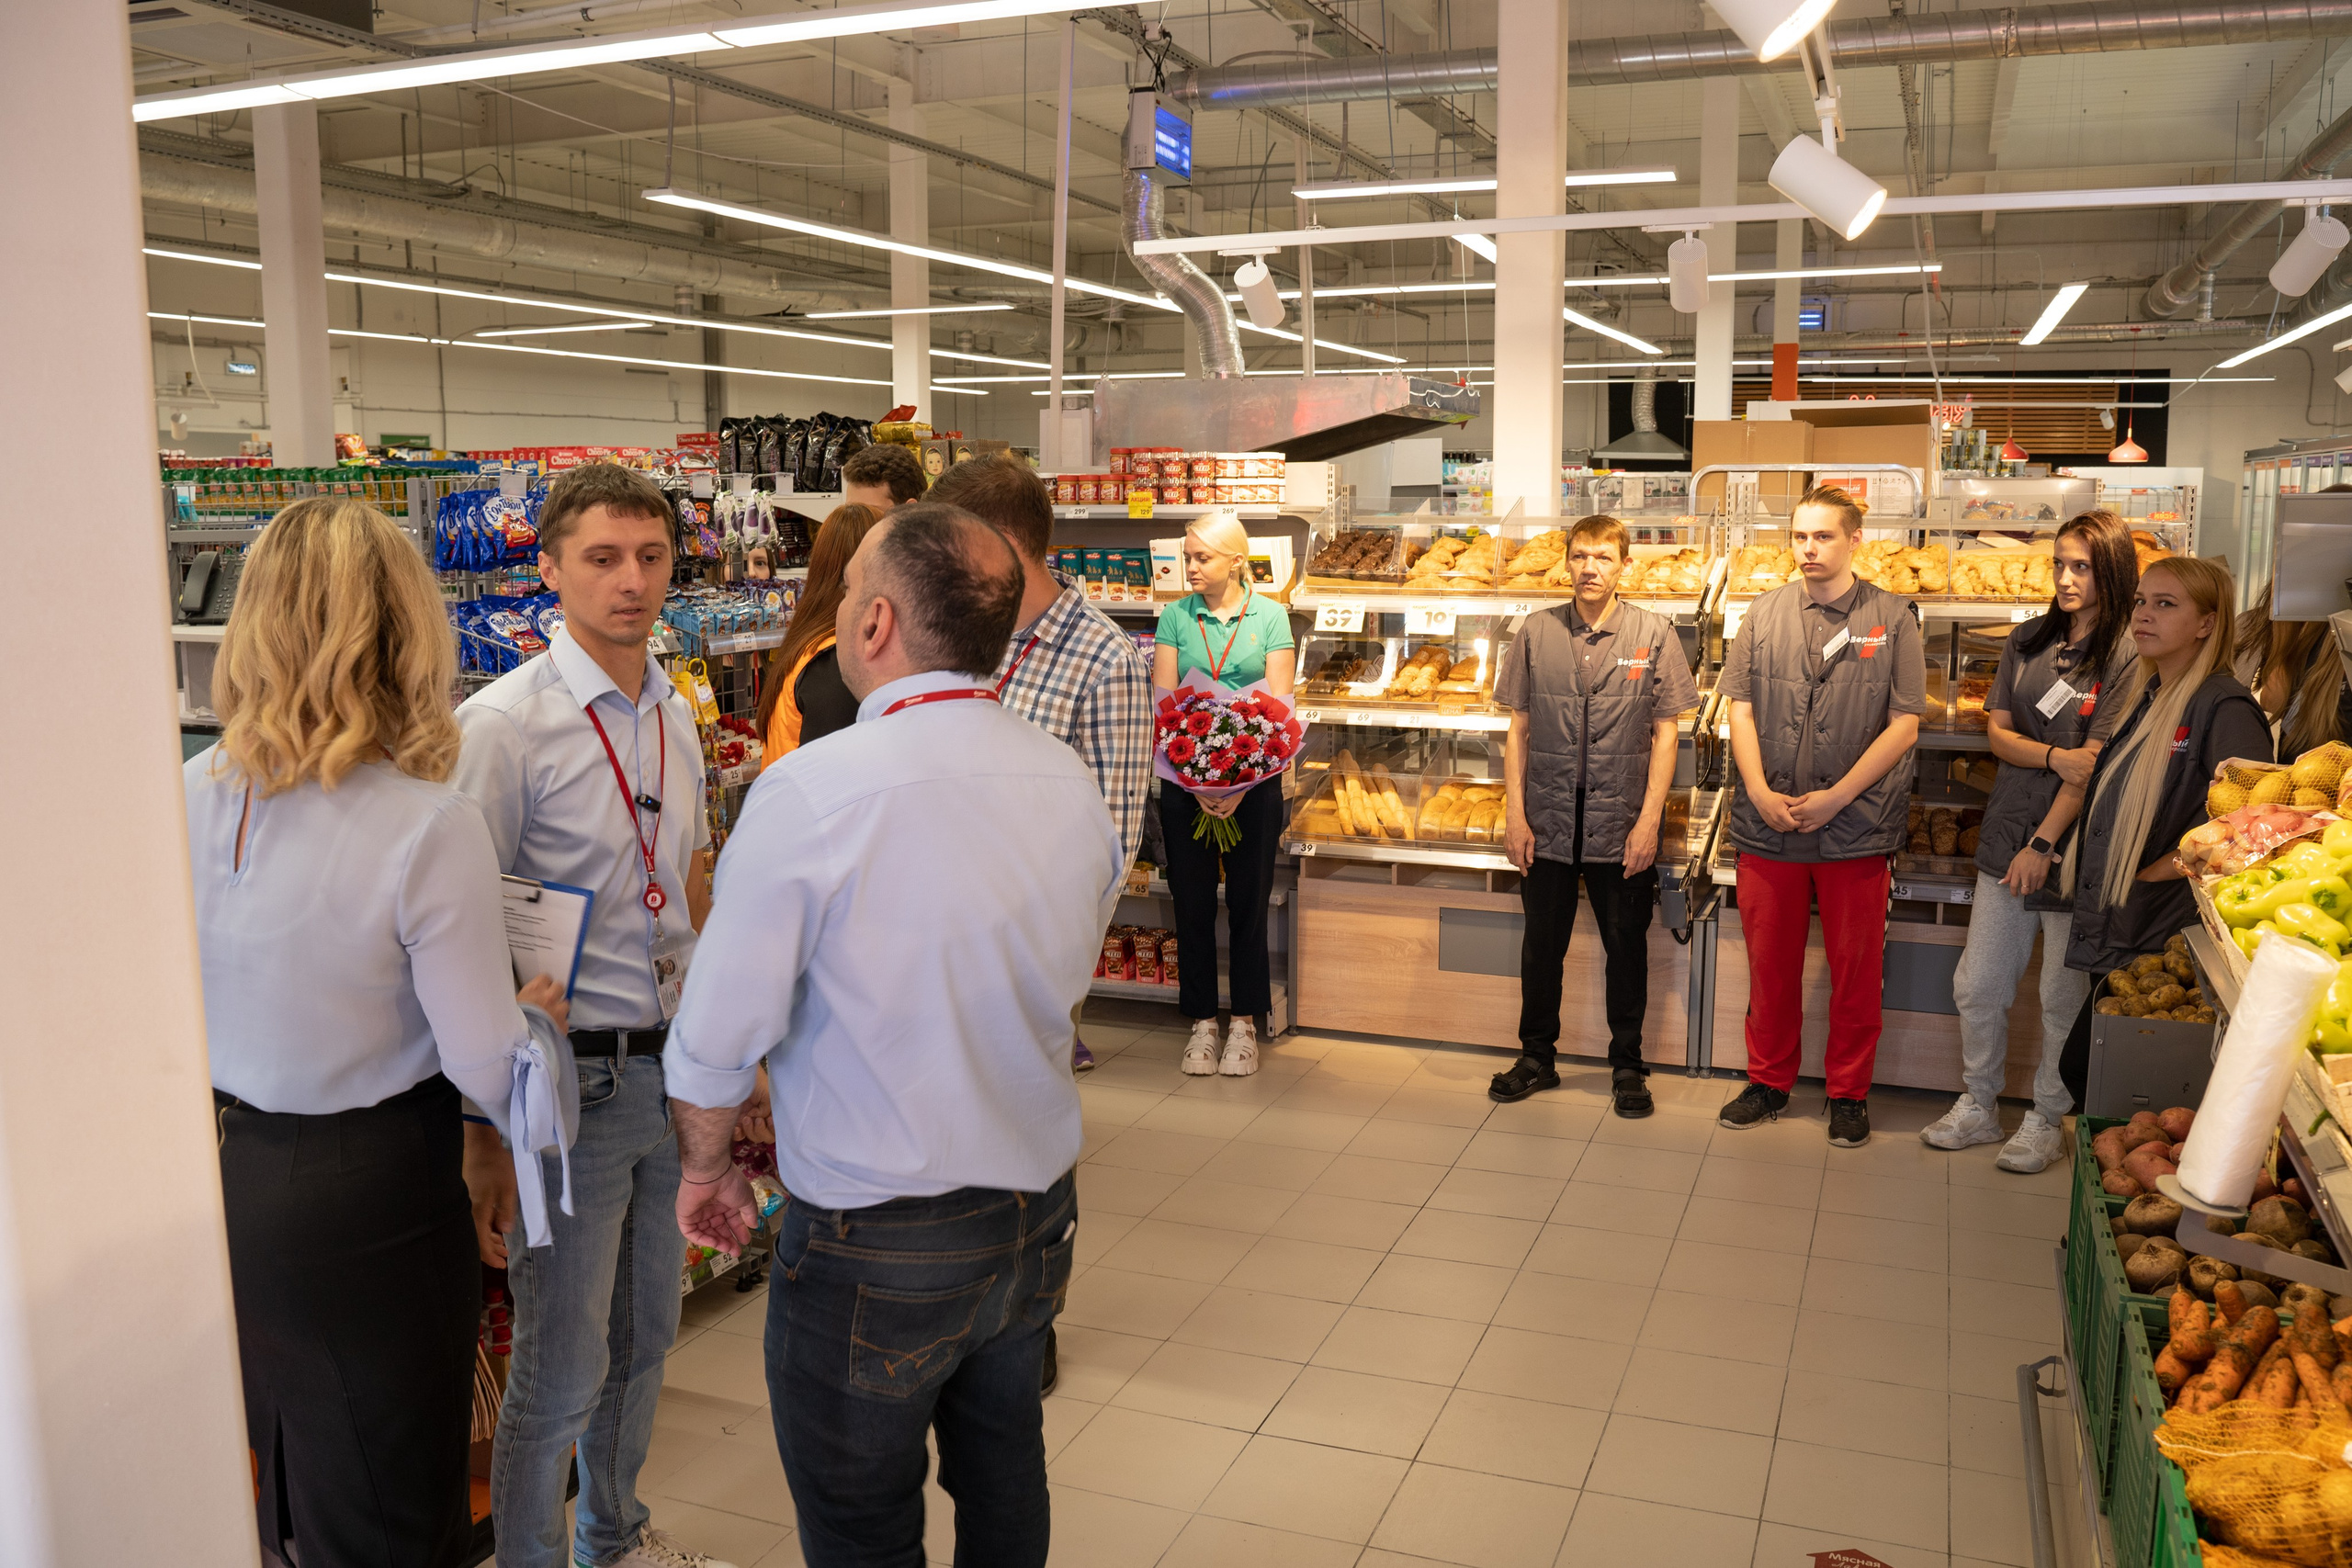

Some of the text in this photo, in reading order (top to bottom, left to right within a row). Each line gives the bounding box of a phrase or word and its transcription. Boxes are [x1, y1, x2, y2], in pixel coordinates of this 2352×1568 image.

[480, 462, 502, 472] OREO
[516, 462, 537, 470] OREO
[1325, 608, 1352, 627] 39
[2024, 610, 2038, 618] 54
[1849, 633, 1887, 644] Верный
[1306, 710, 1317, 719] 69
[730, 770, 739, 779] 25
[1300, 843, 1313, 852] 39
[1136, 885, 1147, 893] 65
[1894, 886, 1908, 896] 45
[1828, 1552, 1881, 1568] Мясная
